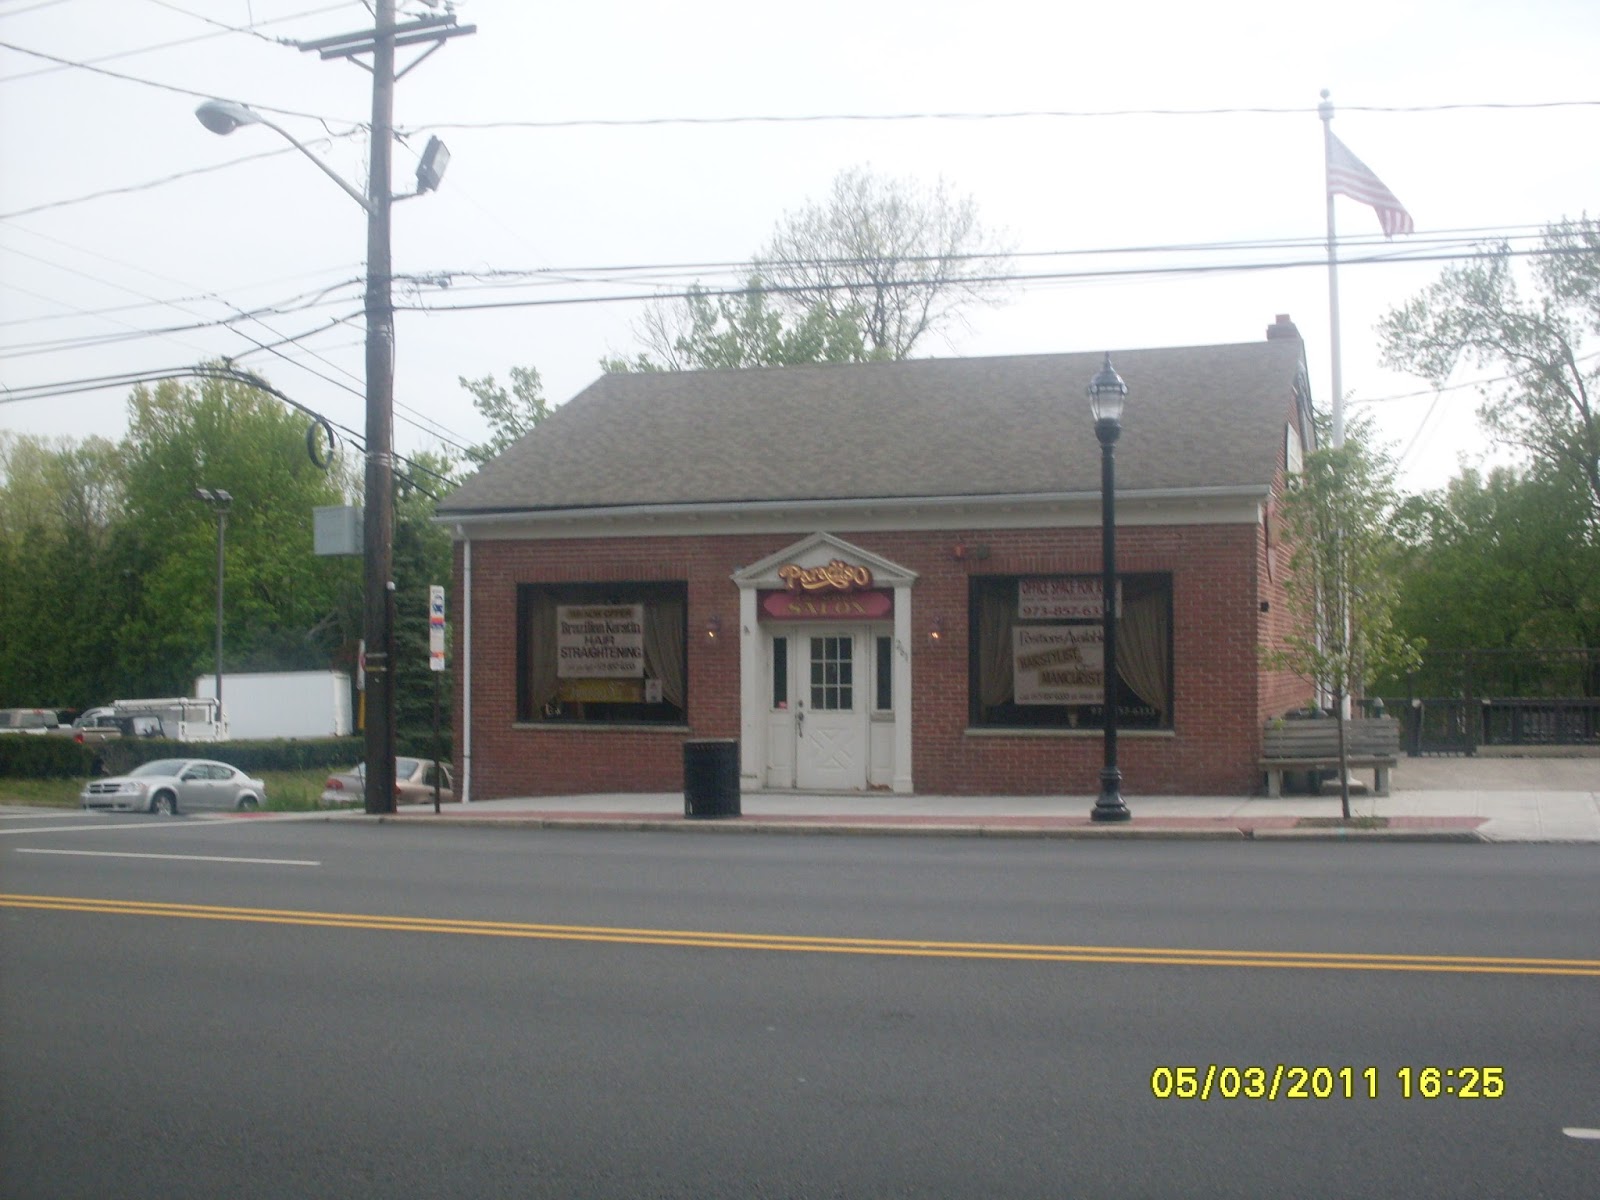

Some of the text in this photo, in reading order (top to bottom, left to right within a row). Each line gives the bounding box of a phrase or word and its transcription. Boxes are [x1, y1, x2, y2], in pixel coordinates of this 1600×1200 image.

[787, 602, 866, 616] SALON
[584, 635, 615, 645] HAIR
[560, 646, 642, 659] STRAIGHTENING
